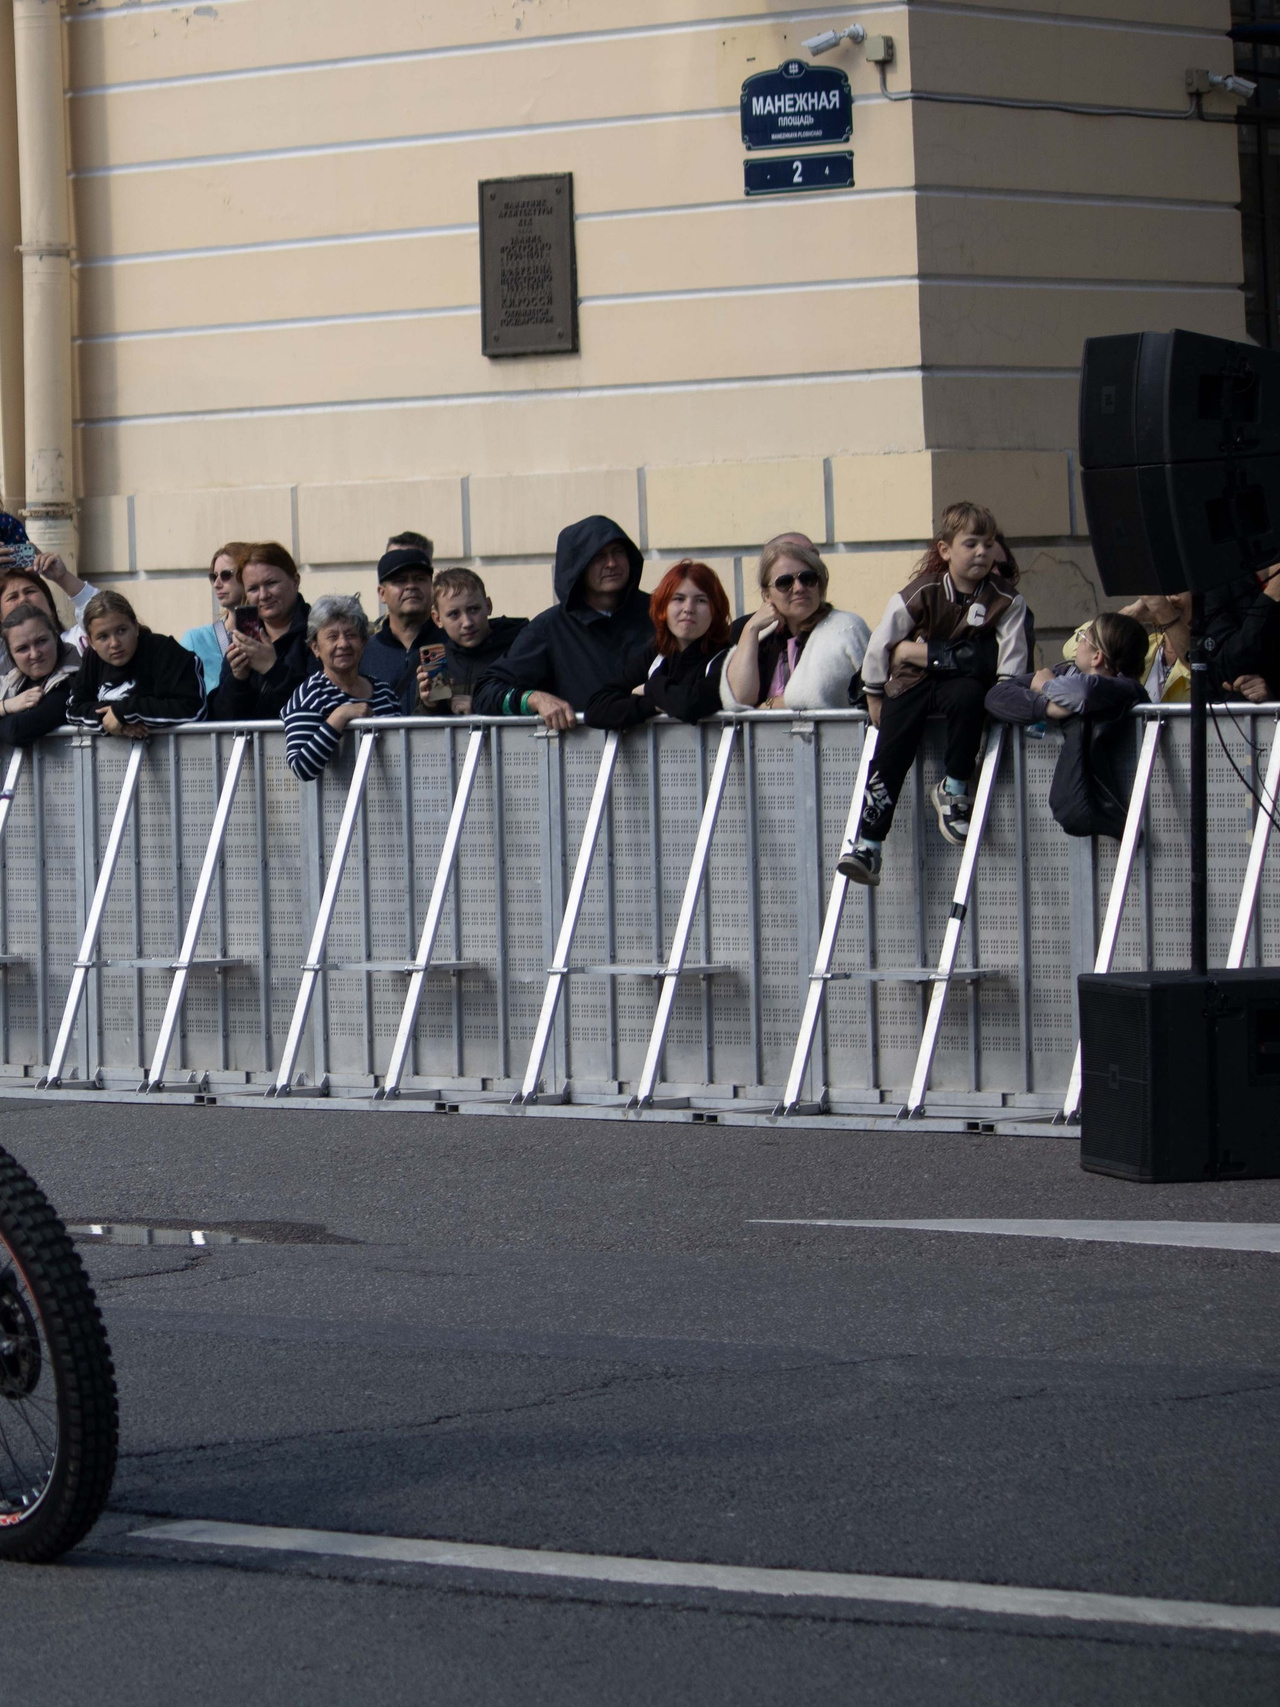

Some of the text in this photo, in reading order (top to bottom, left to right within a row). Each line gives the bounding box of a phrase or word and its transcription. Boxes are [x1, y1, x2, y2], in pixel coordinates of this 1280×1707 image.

[752, 89, 840, 116] МАНЕЖНАЯ
[778, 114, 814, 127] ПЛОЩАДЬ
[792, 160, 803, 183] 2
